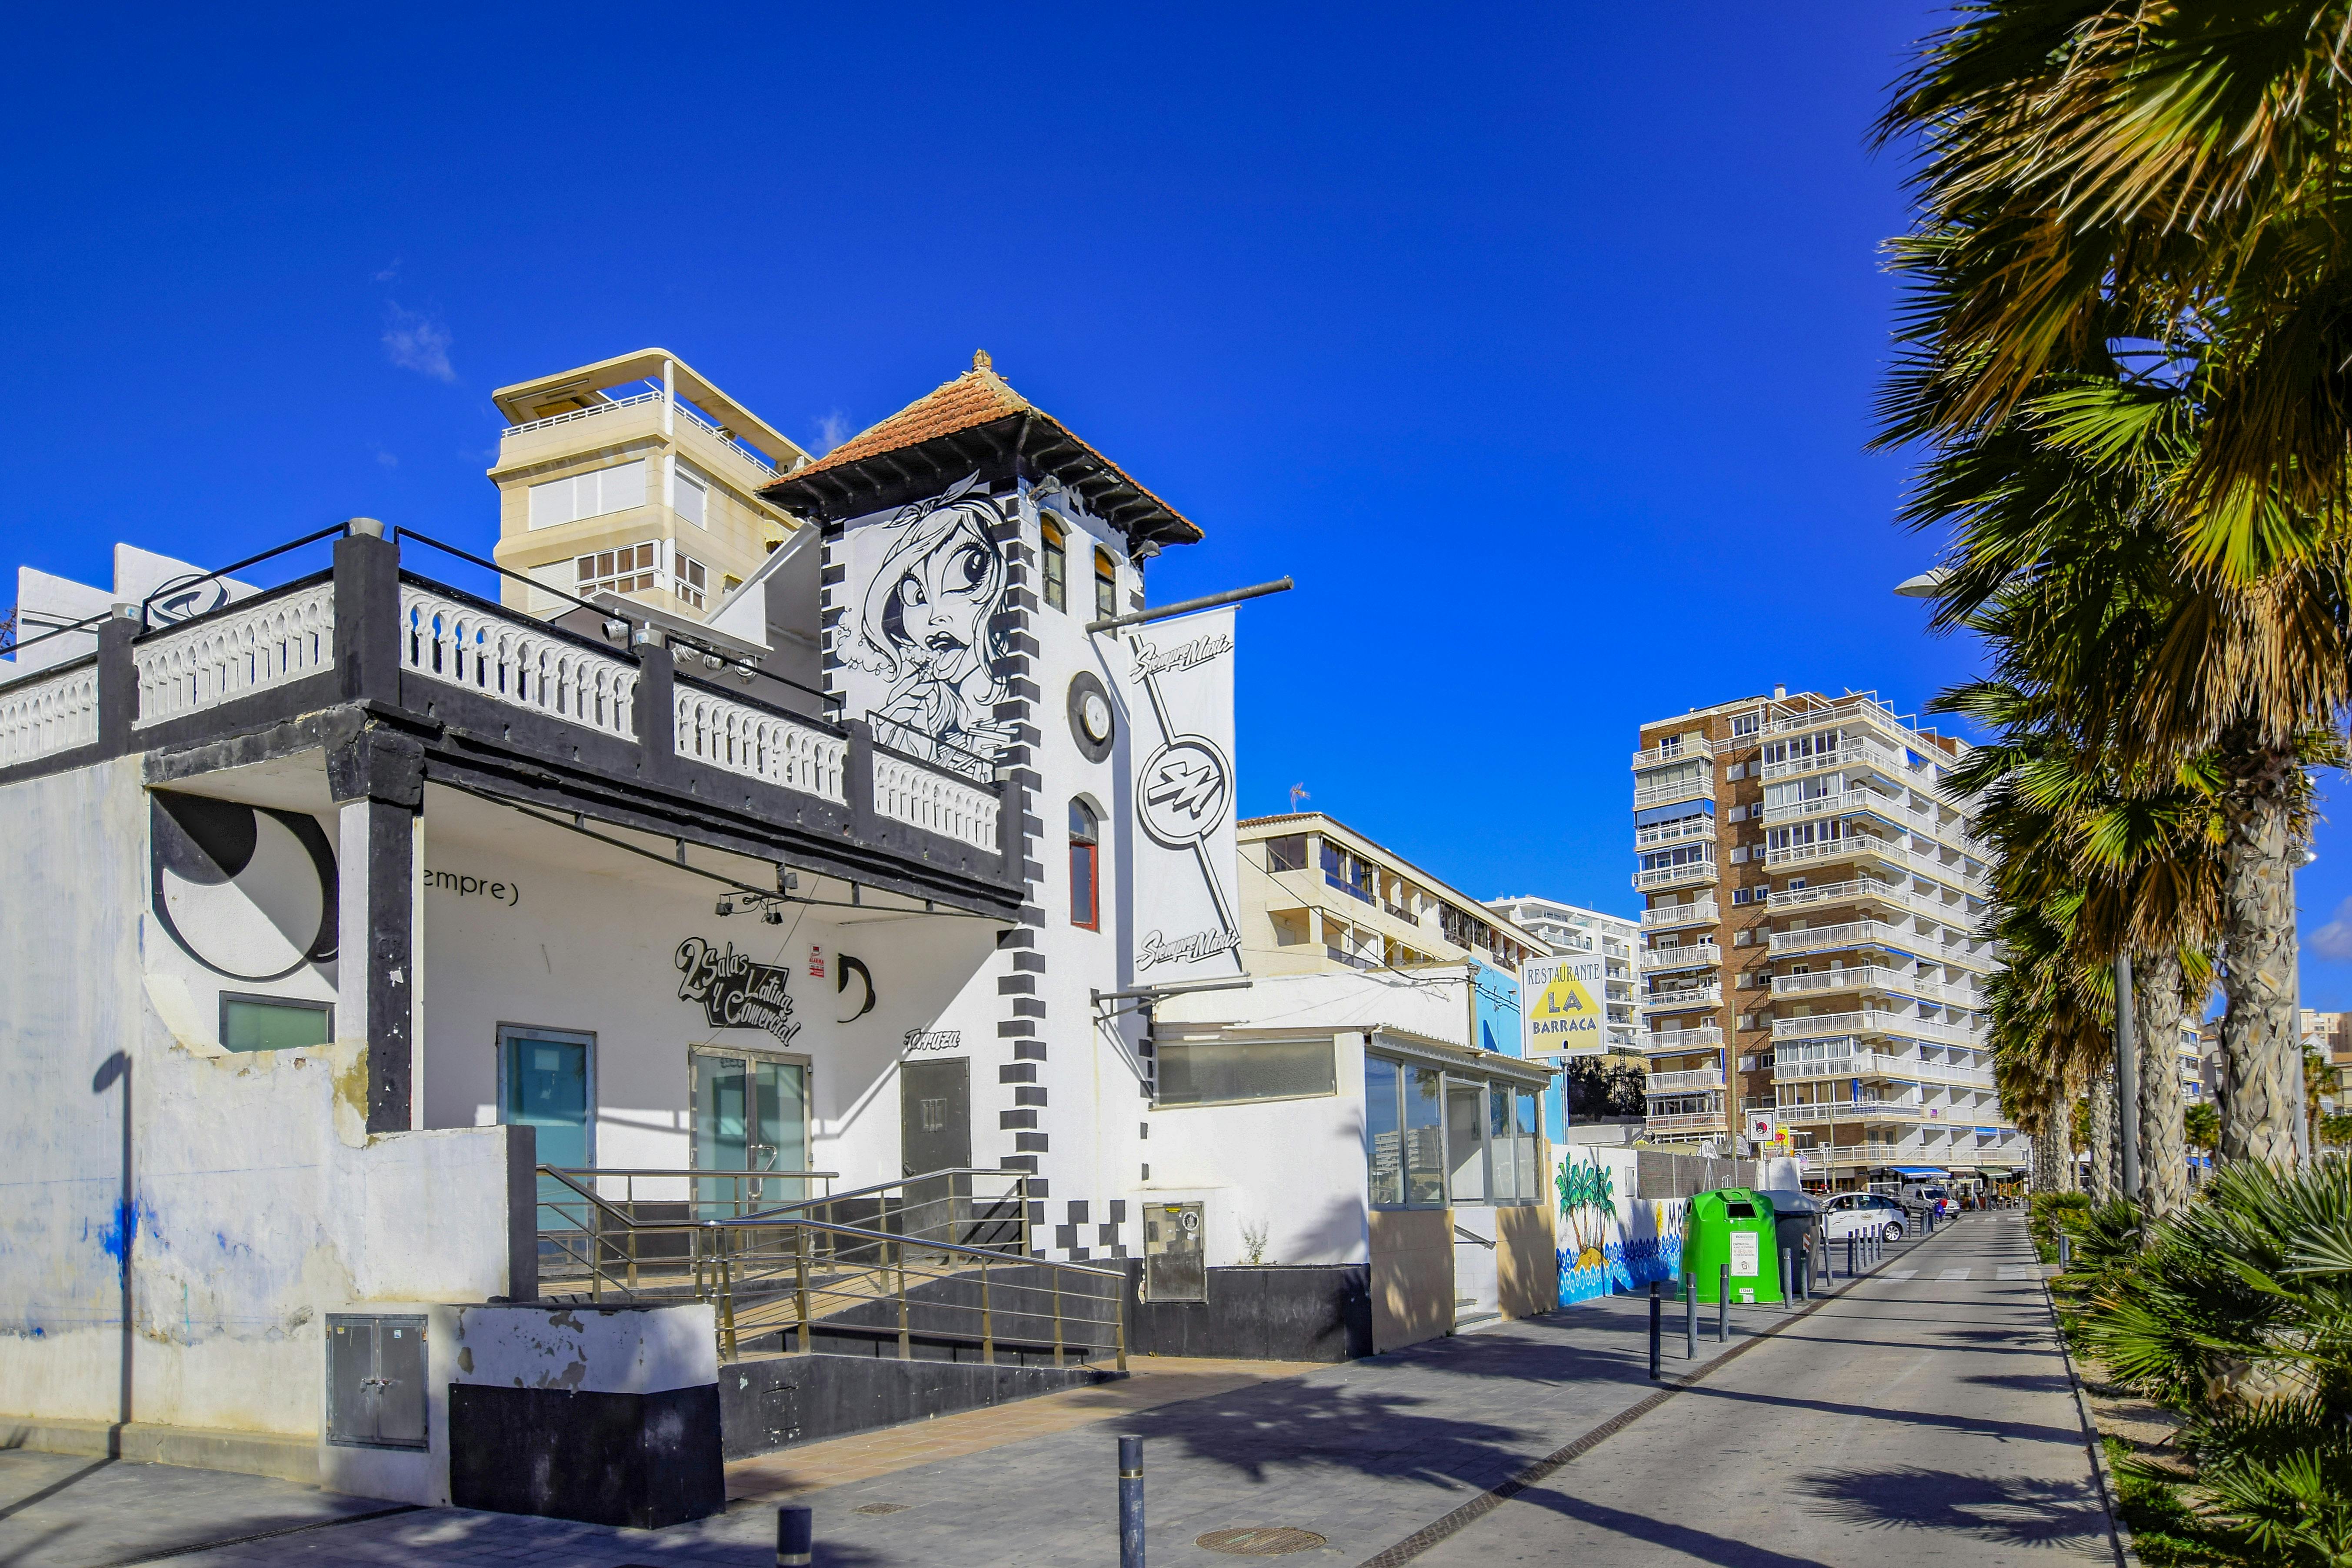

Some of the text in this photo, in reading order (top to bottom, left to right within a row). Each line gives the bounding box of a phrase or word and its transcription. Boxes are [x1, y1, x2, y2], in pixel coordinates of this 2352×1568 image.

[1129, 643, 1190, 684] Siempre
[675, 937, 749, 1002] 2 Salas
[1136, 930, 1197, 972] Siempre
[744, 969, 793, 1014] Latina
[1528, 963, 1600, 985] RESTAURANTE
[724, 990, 801, 1047] Comercial
[1548, 989, 1583, 1013] LA
[903, 1029, 960, 1051] Terraza
[1532, 1017, 1597, 1035] BARRACA
